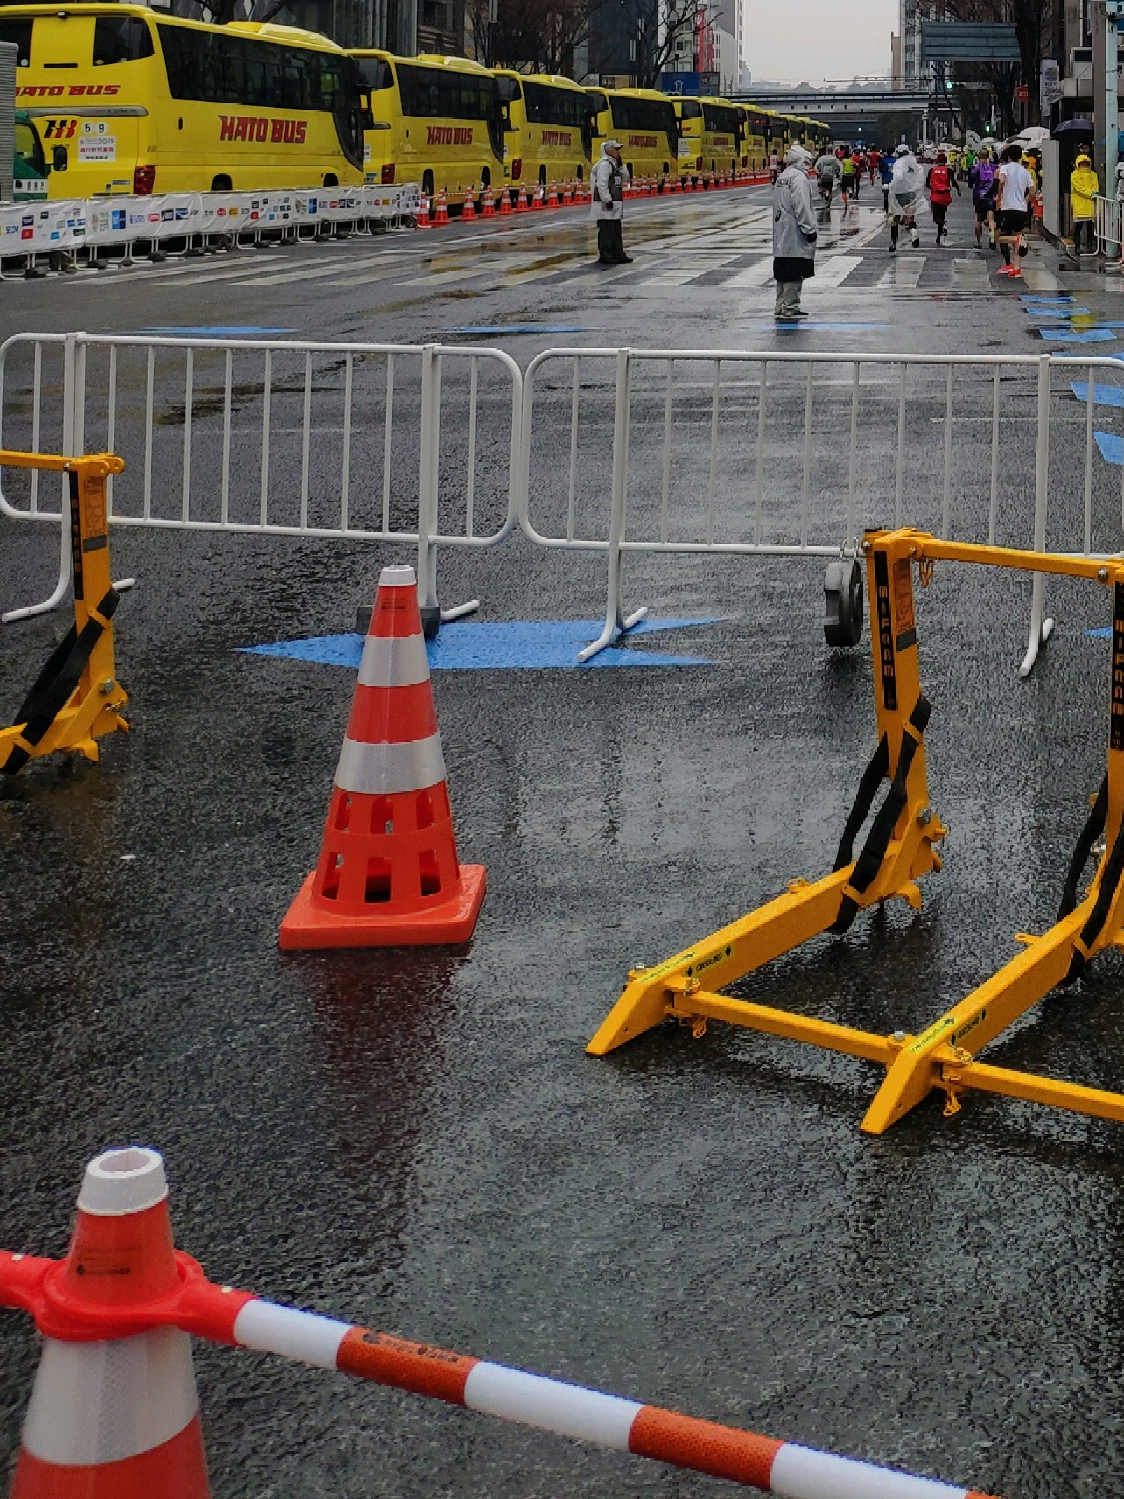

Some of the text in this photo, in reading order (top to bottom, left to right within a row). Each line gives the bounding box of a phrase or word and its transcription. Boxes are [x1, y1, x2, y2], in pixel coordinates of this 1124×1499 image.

[68, 85, 121, 96] BUS
[218, 115, 307, 144] HATO BUS
[427, 126, 473, 145] HATO BUS
